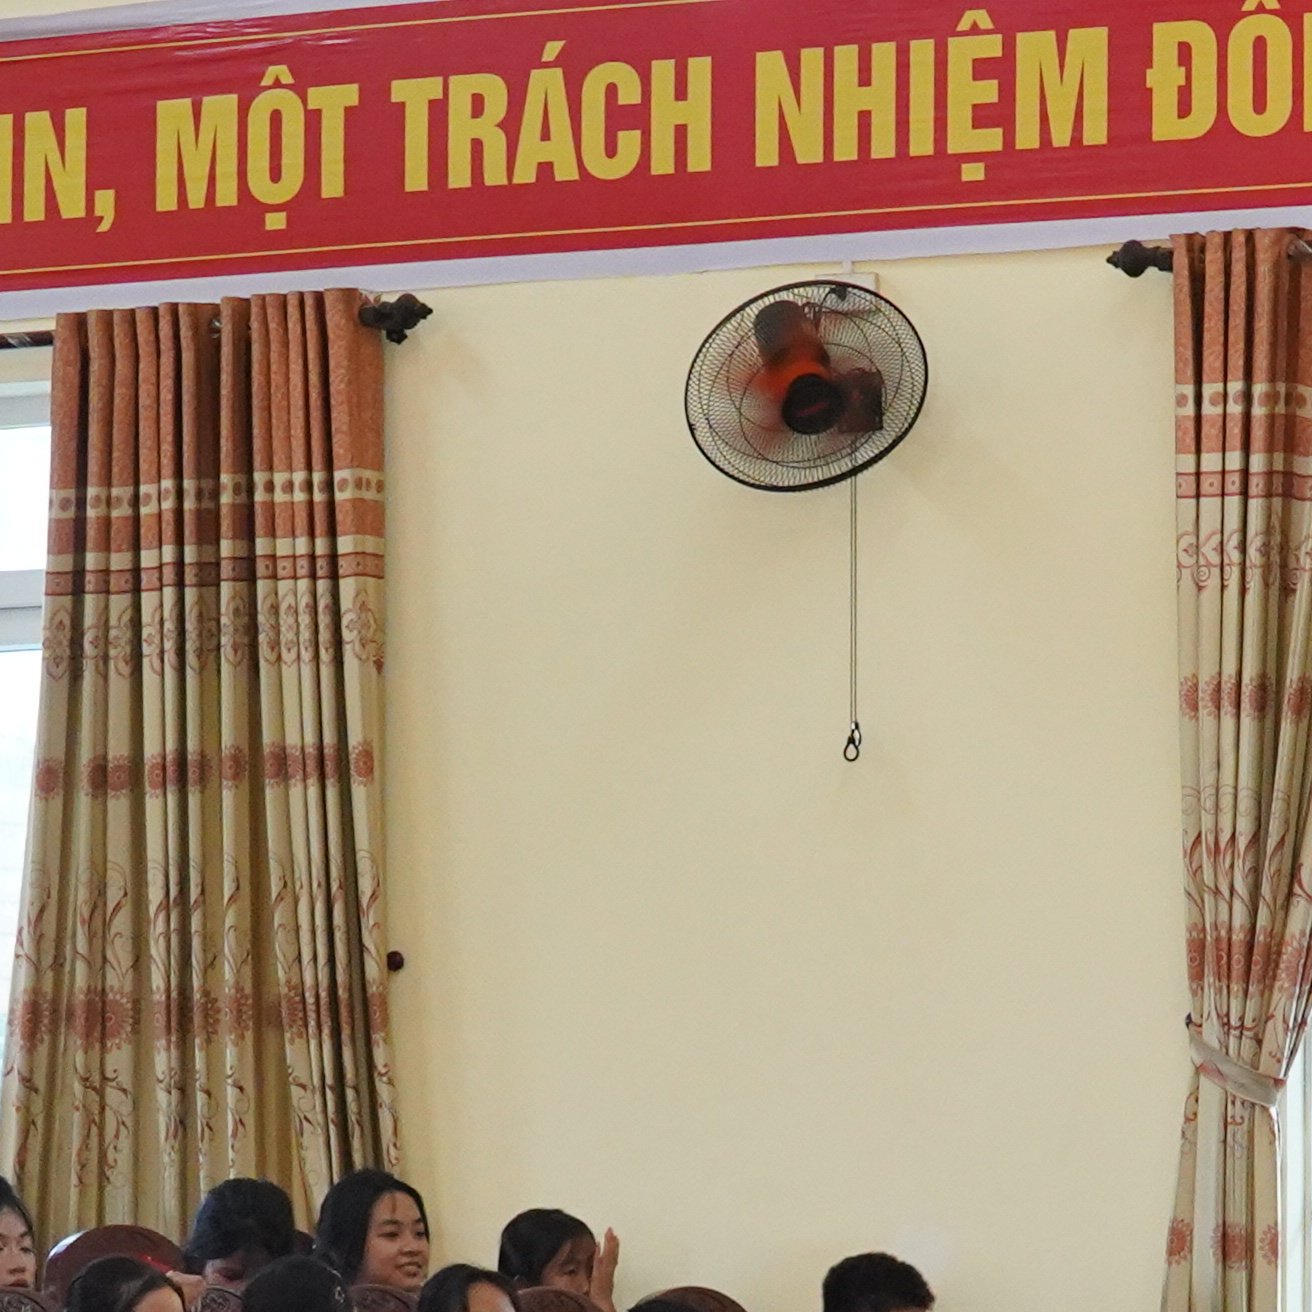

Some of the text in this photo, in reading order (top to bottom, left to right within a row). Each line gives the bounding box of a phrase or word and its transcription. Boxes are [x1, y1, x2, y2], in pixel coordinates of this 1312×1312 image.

[156, 65, 360, 231] MỘT
[391, 41, 712, 192] TRÁCH
[755, 10, 1108, 181] NHIỆM
